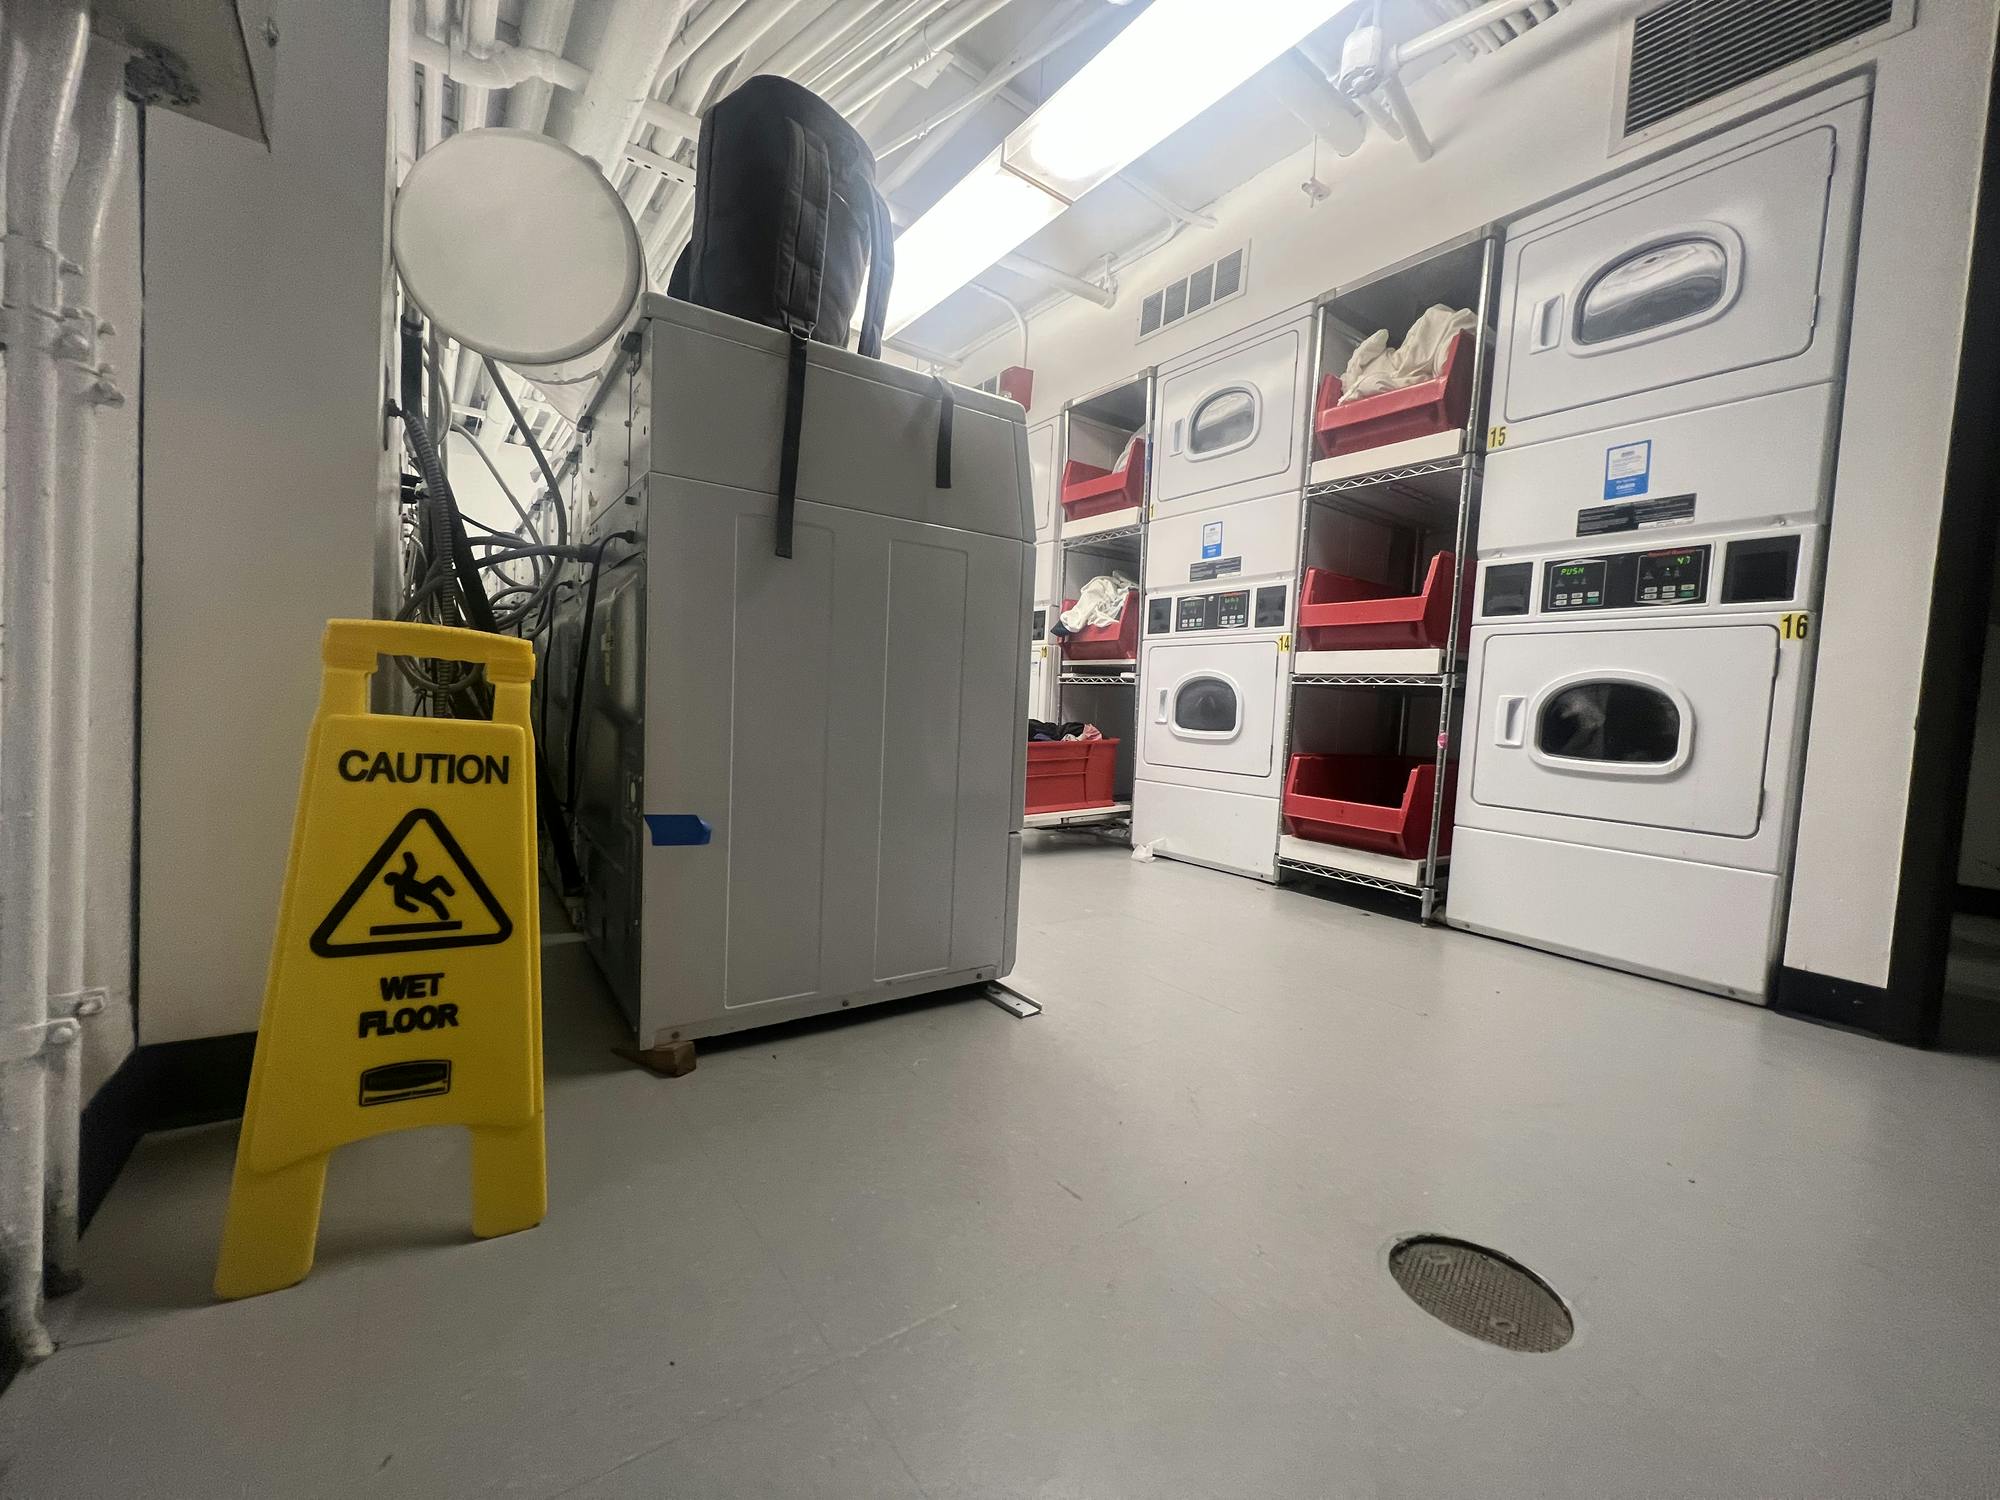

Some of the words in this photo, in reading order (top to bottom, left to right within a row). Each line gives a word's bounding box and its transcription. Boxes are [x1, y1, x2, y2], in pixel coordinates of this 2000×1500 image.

[1490, 426, 1506, 447] 15
[1560, 567, 1585, 576] PUSH
[1783, 613, 1808, 639] 16
[1280, 635, 1289, 651] 14
[339, 750, 509, 784] CAUTION
[380, 973, 445, 1000] WET
[359, 1003, 459, 1038] FLOOR
